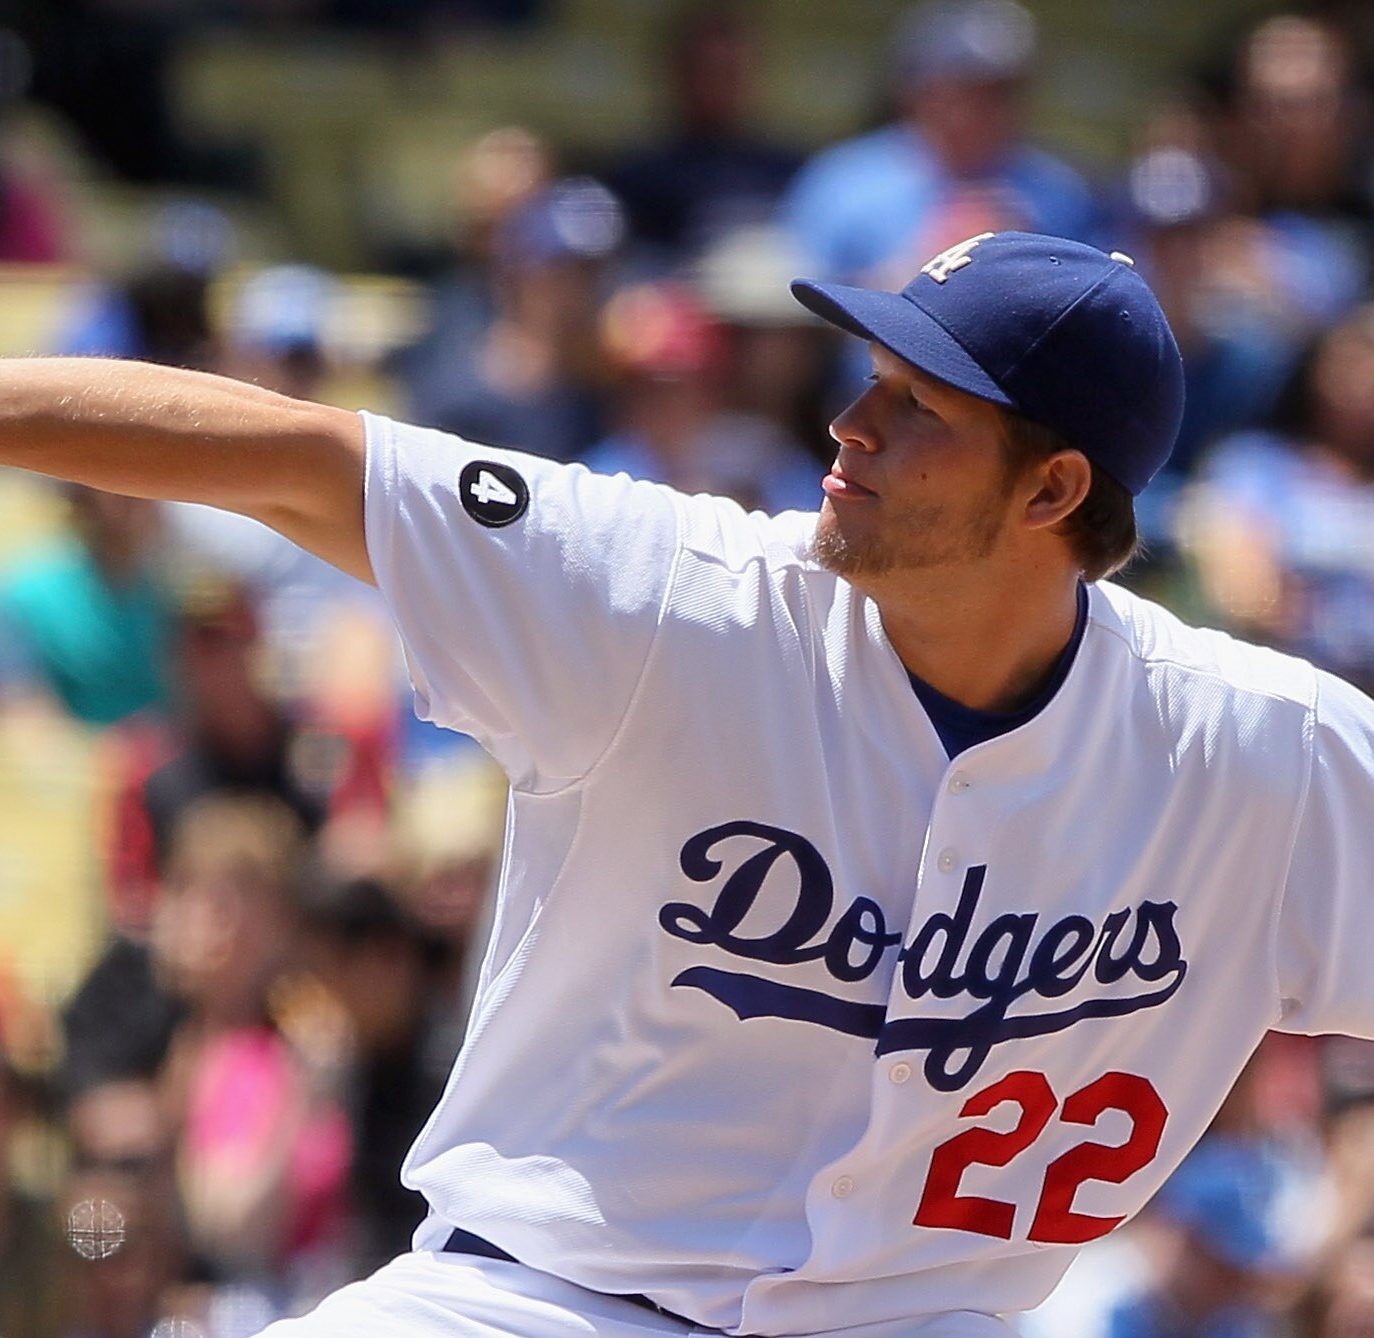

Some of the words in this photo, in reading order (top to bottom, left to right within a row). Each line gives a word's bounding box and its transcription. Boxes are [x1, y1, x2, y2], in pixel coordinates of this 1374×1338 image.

[470, 470, 517, 505] 4
[659, 820, 1189, 1092] Dodgers
[912, 1070, 1170, 1245] 22
